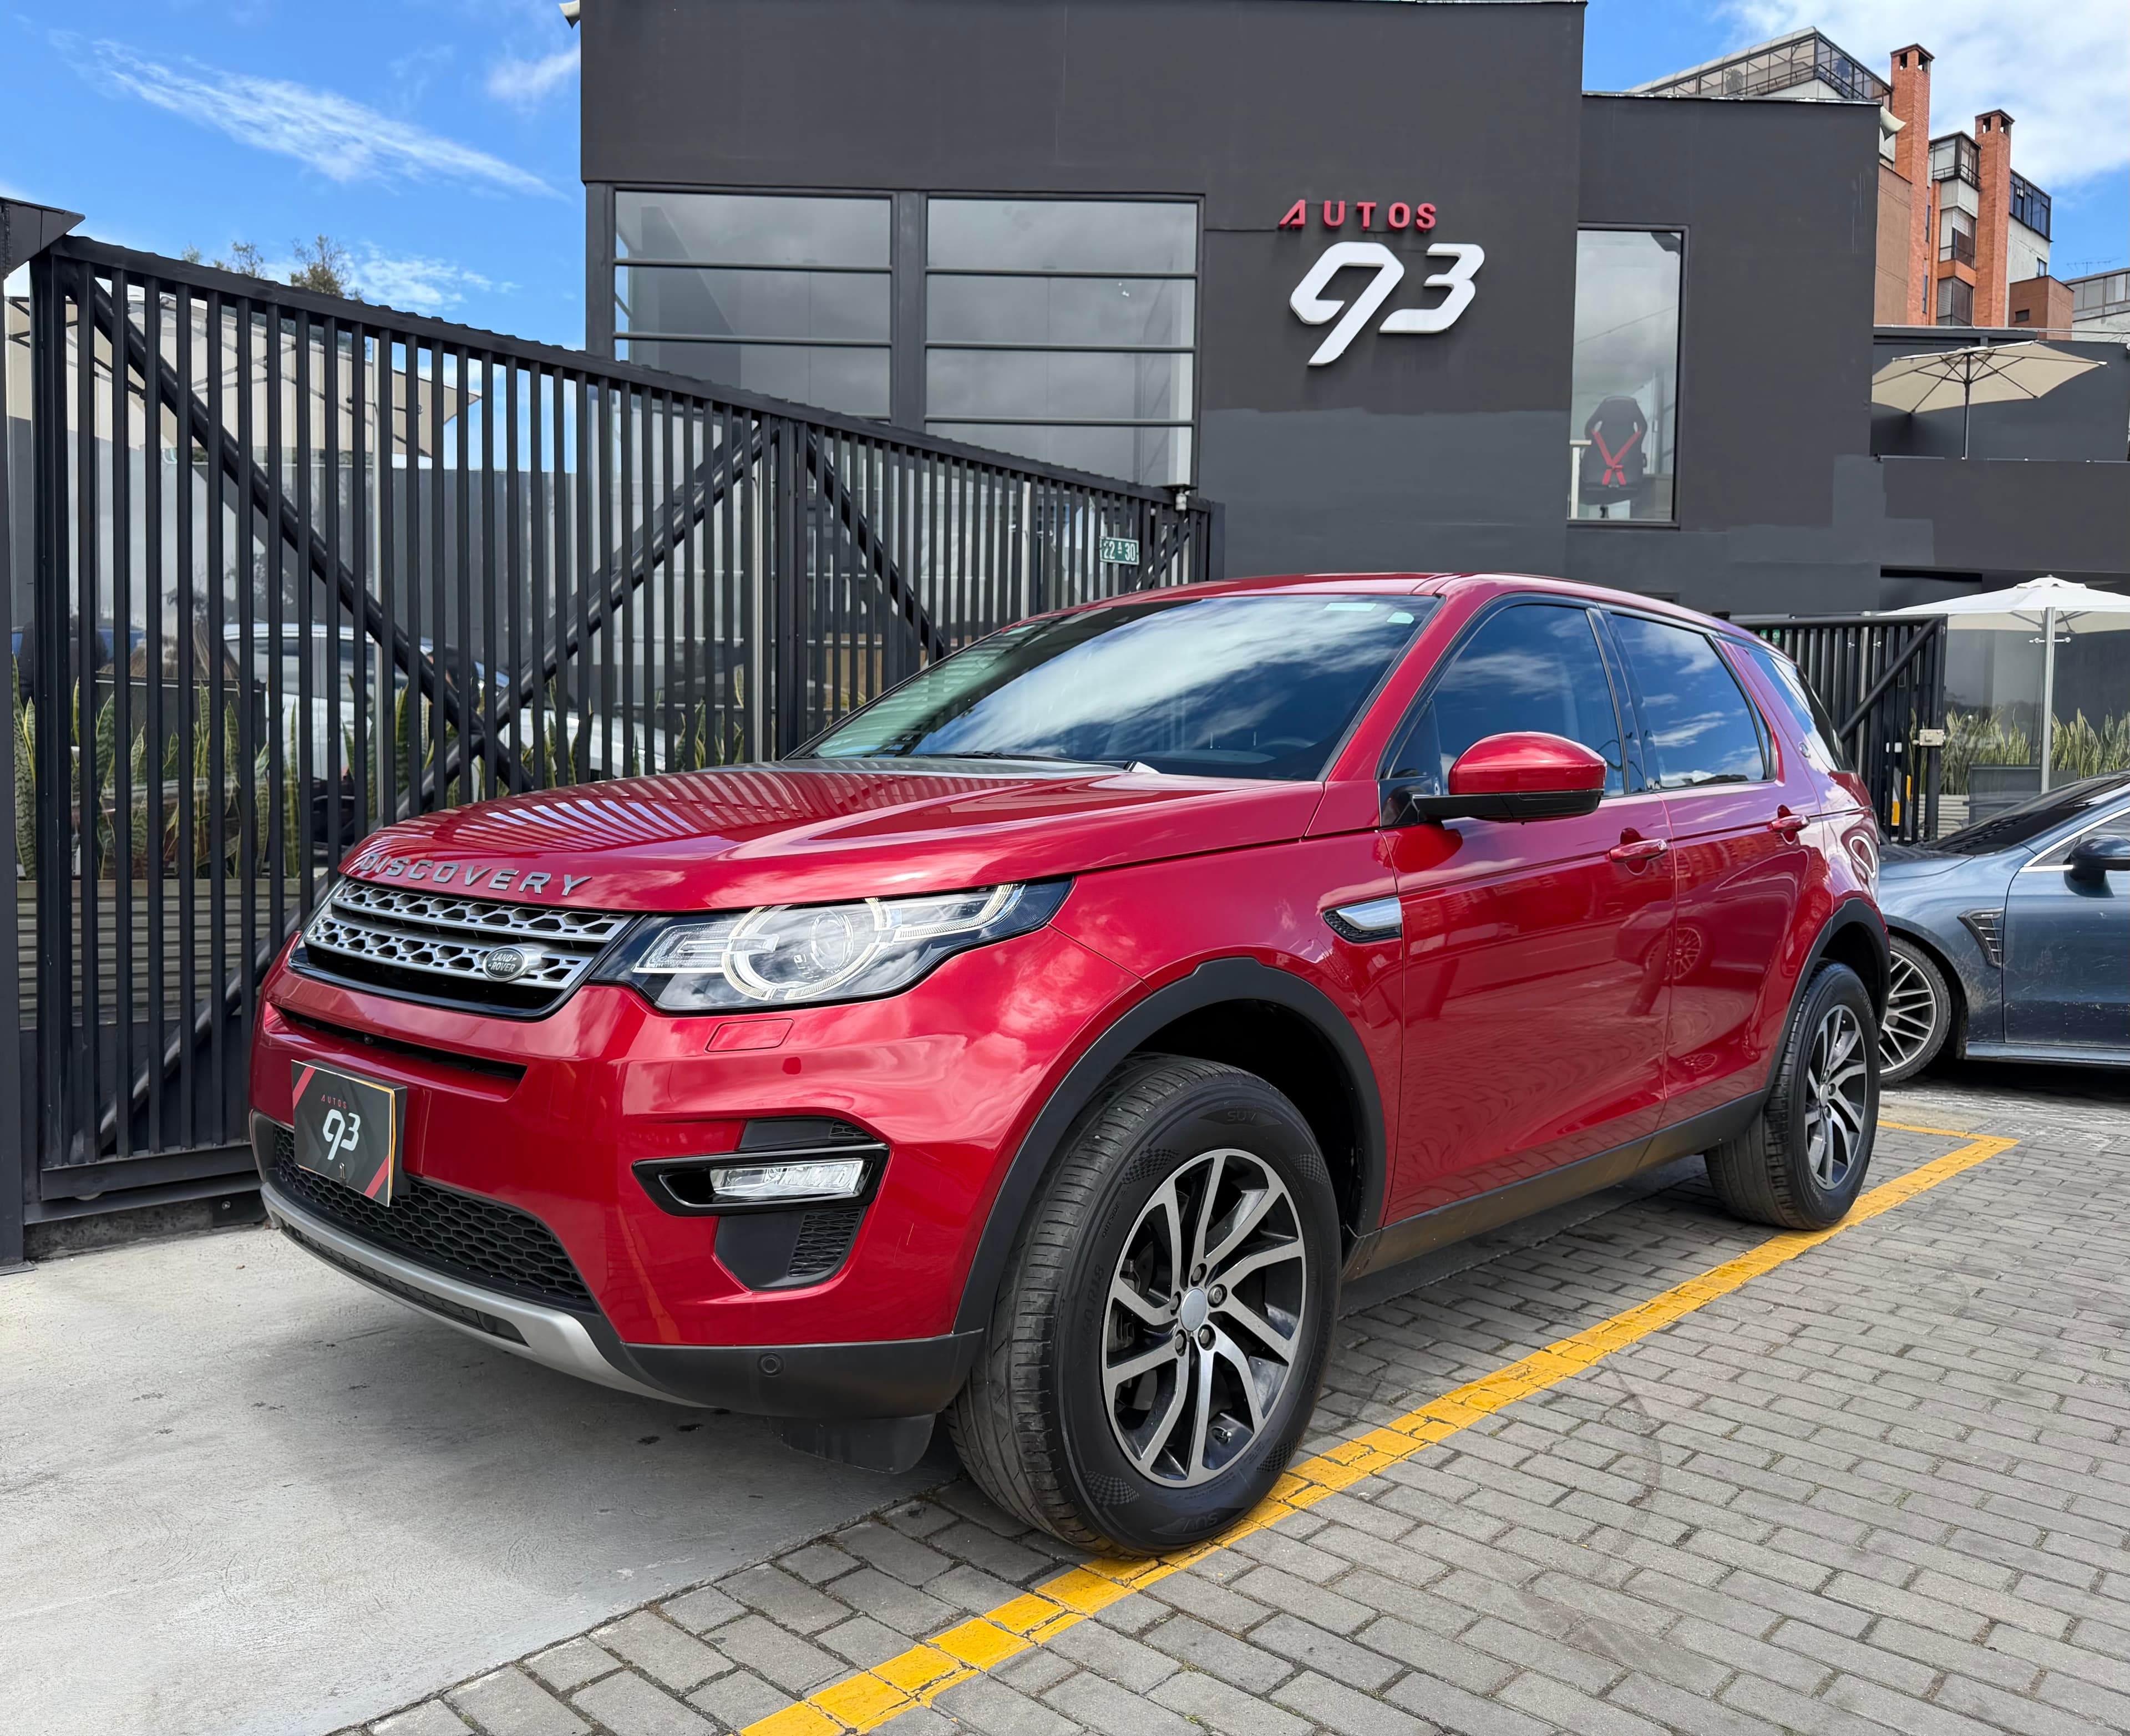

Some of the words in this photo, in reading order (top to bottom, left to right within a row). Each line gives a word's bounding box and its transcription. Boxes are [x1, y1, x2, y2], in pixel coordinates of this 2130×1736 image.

[1278, 199, 1437, 231] AUTOS
[1289, 241, 1485, 366] 93
[1103, 540, 1115, 559] 22
[1124, 542, 1135, 561] 30
[358, 852, 592, 896] DISCOVERY
[490, 962, 516, 972] ROVER
[492, 953, 513, 962] LAND
[321, 1094, 347, 1109] AUTOS
[323, 1109, 361, 1160] 93
[1102, 1202, 1121, 1238] OUTSIDE
